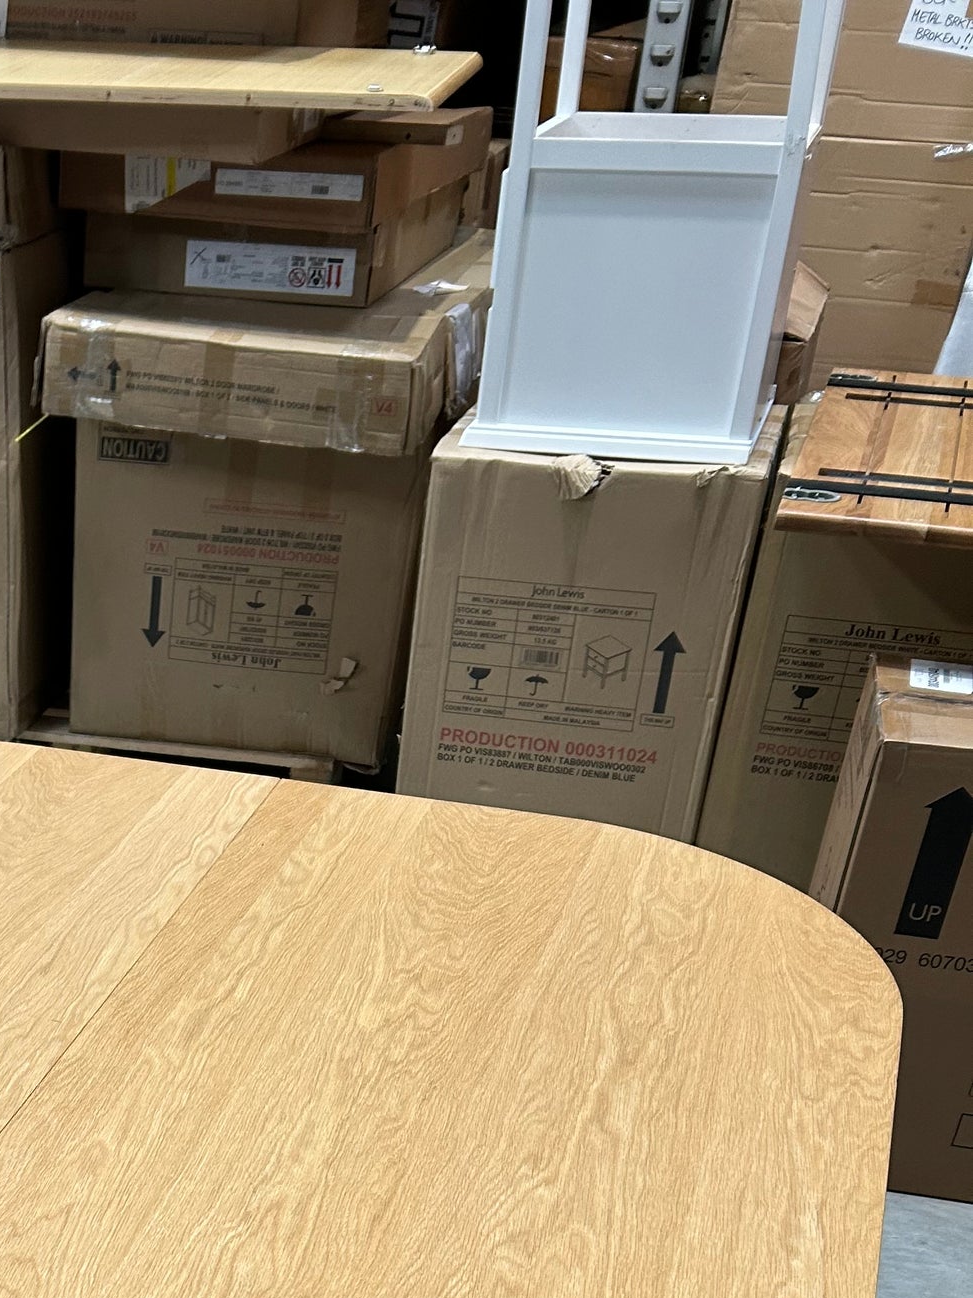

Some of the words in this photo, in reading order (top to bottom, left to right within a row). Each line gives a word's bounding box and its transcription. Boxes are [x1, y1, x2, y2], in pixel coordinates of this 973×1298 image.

[911, 9, 942, 25] METAL
[944, 14, 973, 30] BRKT
[375, 402, 394, 414] V4
[102, 437, 166, 460] CAUTION
[150, 542, 165, 553] V4
[259, 549, 340, 565] PRODUCTION
[531, 585, 555, 598] John
[557, 588, 584, 599] Lewis
[457, 606, 480, 614] STOCK
[467, 619, 497, 627] NUMBER
[845, 623, 885, 640] John
[892, 627, 942, 645] Lewis
[452, 641, 486, 650] BARCODE
[782, 646, 808, 656] STOCK
[809, 649, 820, 657] NO
[211, 652, 246, 666] Lewis
[251, 655, 282, 669] John
[778, 657, 790, 666] PO
[791, 659, 825, 669] NUMBER
[776, 670, 803, 679] GROSS
[804, 672, 835, 683] WEIGHT
[444, 704, 472, 712] COUNTRY
[763, 725, 793, 734] COUNTRY
[805, 730, 827, 738] ORIGIN
[440, 727, 560, 753] PRODUCTION
[564, 741, 658, 764] 000311024
[756, 742, 844, 763] PRODUCTIO
[459, 745, 473, 754] PO
[518, 752, 552, 764] WILTON
[753, 754, 775, 765] FWG
[776, 758, 791, 767] PO
[437, 752, 456, 762] BOX
[464, 756, 476, 764] OF
[497, 760, 535, 772] DRAWER
[536, 764, 575, 776] BEDSIDE
[581, 769, 610, 780] DENIM
[612, 773, 636, 783] BLUE
[750, 765, 771, 775] BOX
[780, 769, 794, 778] OF
[815, 773, 839, 784] DRA
[908, 902, 942, 922] UP
